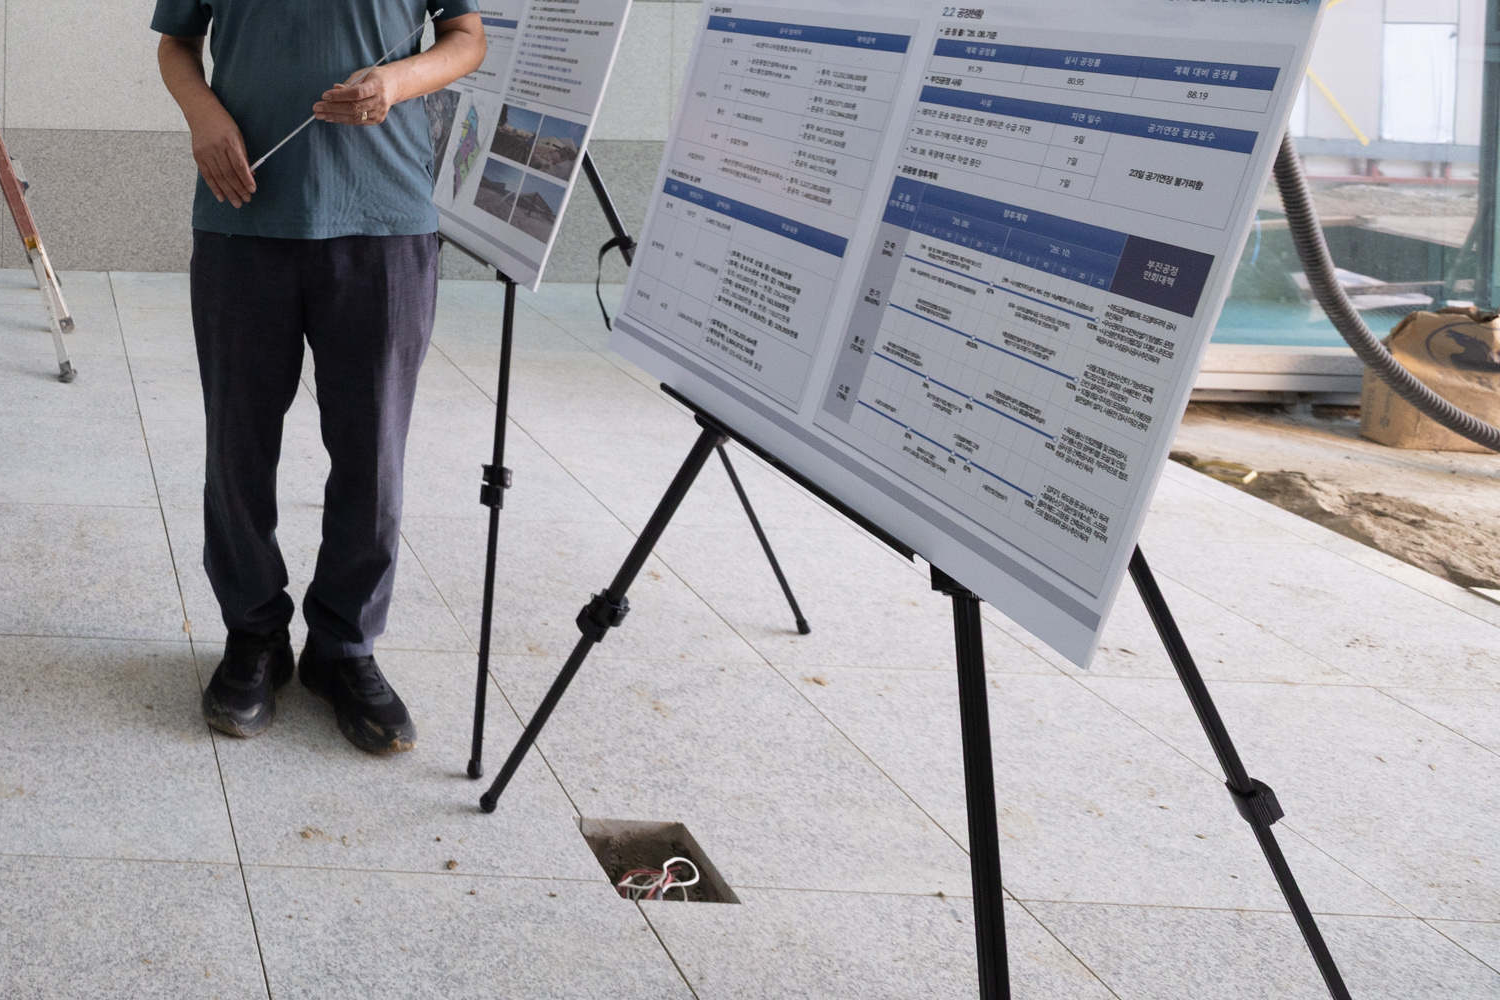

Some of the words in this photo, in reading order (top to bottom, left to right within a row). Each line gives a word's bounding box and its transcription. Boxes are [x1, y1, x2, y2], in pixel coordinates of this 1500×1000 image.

[942, 6, 956, 17] 2.2
[957, 8, 984, 19] 공정현황
[978, 47, 996, 57] 공정률
[1064, 56, 1078, 64] 실시
[1080, 57, 1101, 67] 공정률
[967, 65, 983, 73] 91.79
[1174, 66, 1190, 75] 계획
[1192, 67, 1210, 77] 대비
[1212, 69, 1238, 80] 공정률
[1067, 77, 1085, 86] 80.95
[1186, 90, 1209, 100] 88.19
[980, 99, 993, 107] 사유
[921, 108, 938, 117] 레미콘
[973, 117, 985, 126] 인한
[985, 119, 1004, 129] 레미콘
[1004, 123, 1017, 132] 수급
[1018, 124, 1031, 134] 지연
[1071, 112, 1086, 122] 지연
[1087, 114, 1102, 124] 일수
[1147, 123, 1180, 136] 공기연장
[1182, 128, 1216, 141] 필요일수
[963, 135, 975, 145] 작업
[975, 138, 988, 148] 중단
[1073, 135, 1085, 144] 9일
[957, 155, 969, 165] 작업
[969, 158, 981, 168] 중단
[1066, 157, 1078, 166] 7일
[1059, 178, 1071, 188] 7일
[1128, 168, 1145, 179] 23일
[1145, 171, 1174, 185] 공기연장
[1173, 177, 1203, 191] 불가피함
[1003, 209, 1028, 222] 향후계획
[1049, 244, 1061, 254] '26.
[1061, 248, 1071, 257] 10.
[1147, 260, 1179, 276] 부진공정
[1143, 270, 1175, 287] 만회대책
